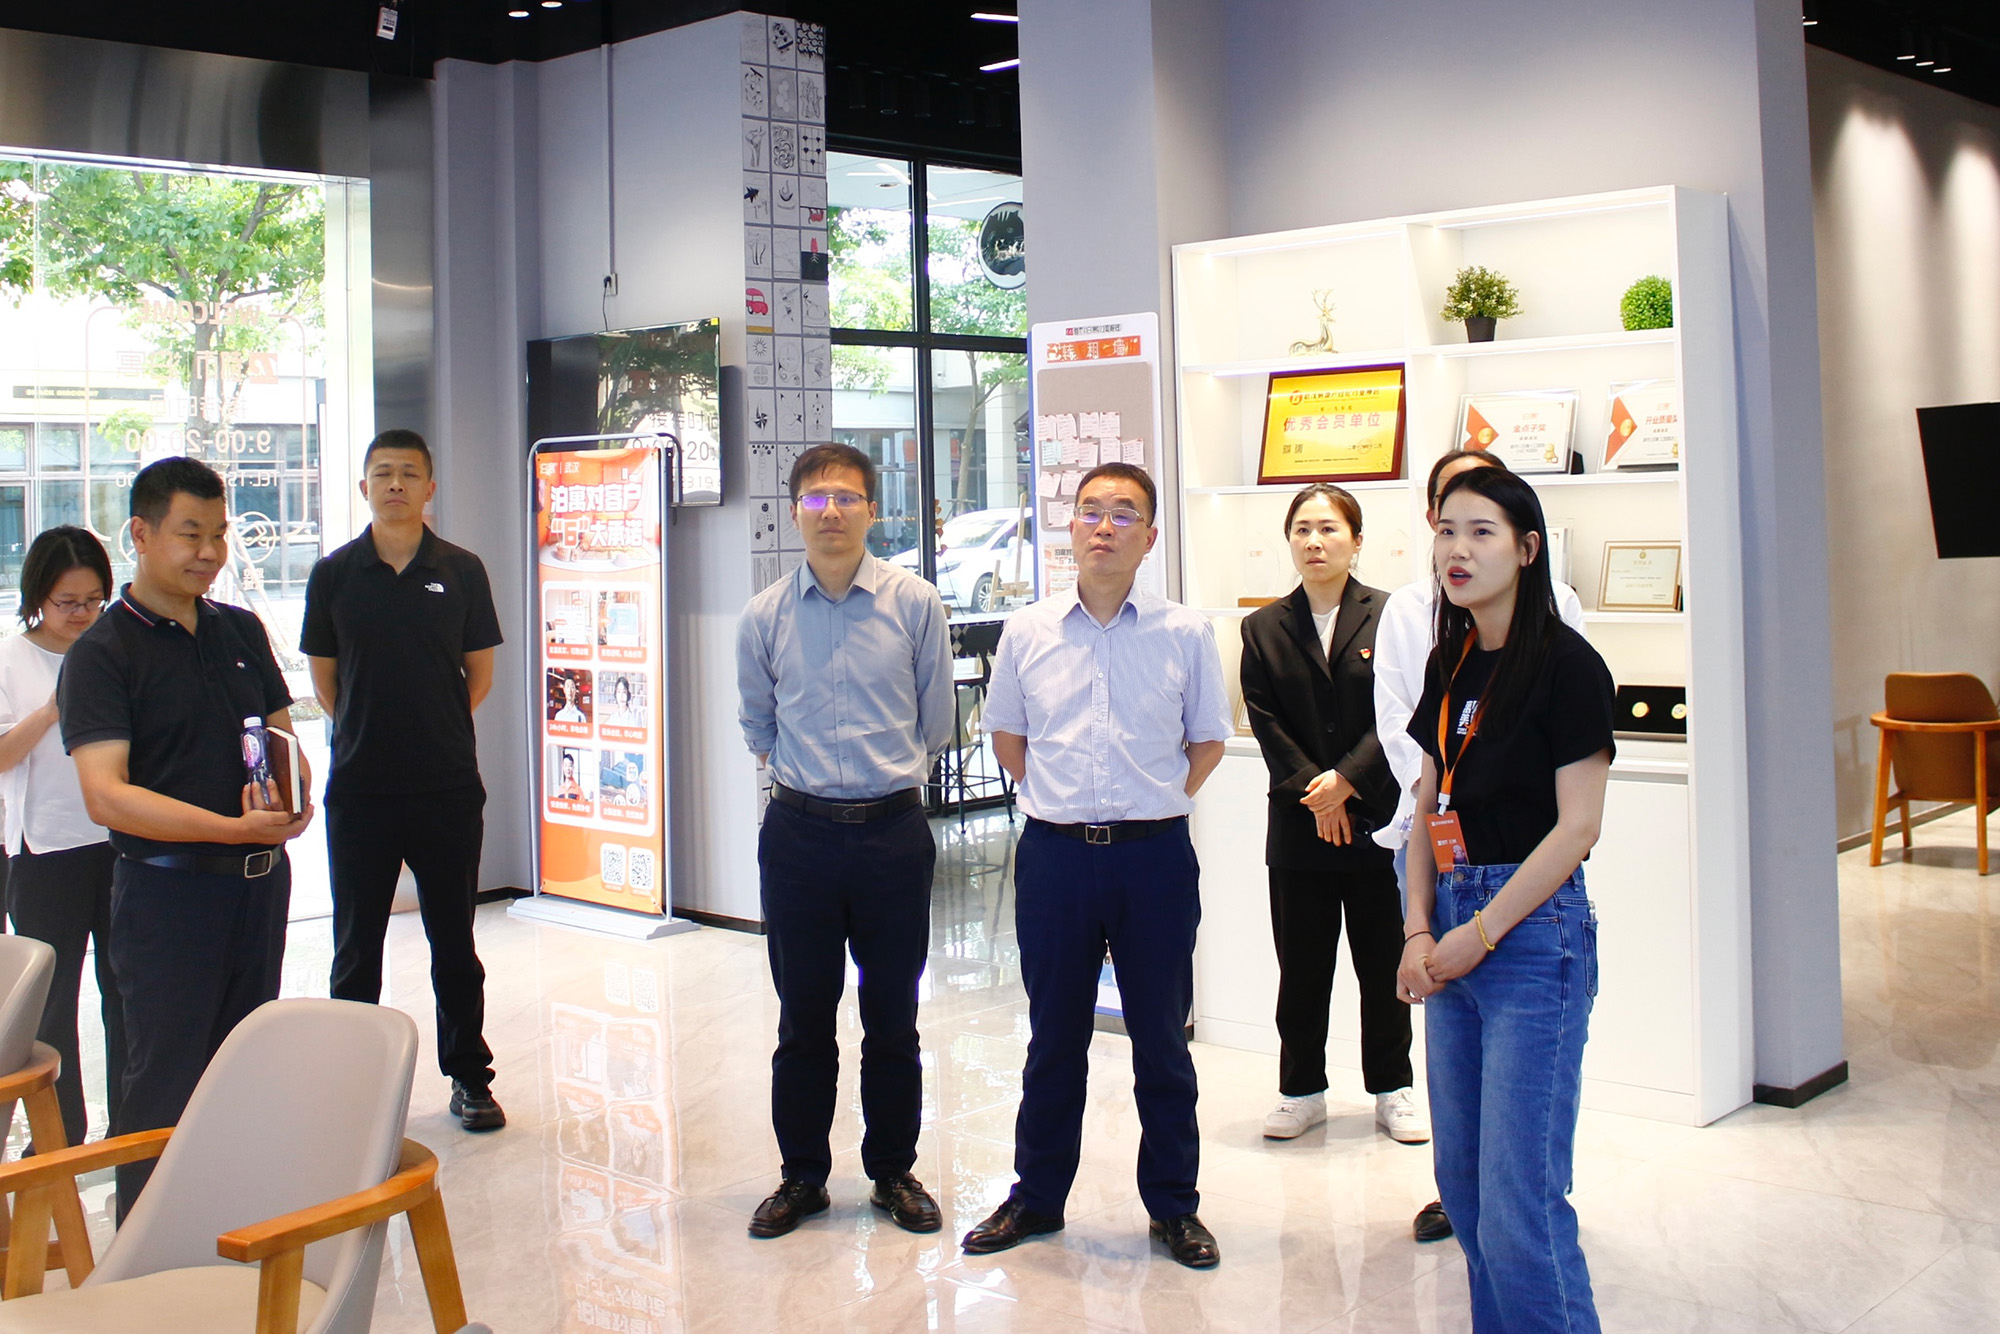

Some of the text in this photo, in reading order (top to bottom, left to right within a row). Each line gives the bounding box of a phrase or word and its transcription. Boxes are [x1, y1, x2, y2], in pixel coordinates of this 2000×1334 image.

[1283, 412, 1381, 432] 优秀会员单位
[550, 483, 643, 513] 泊寓对客户
